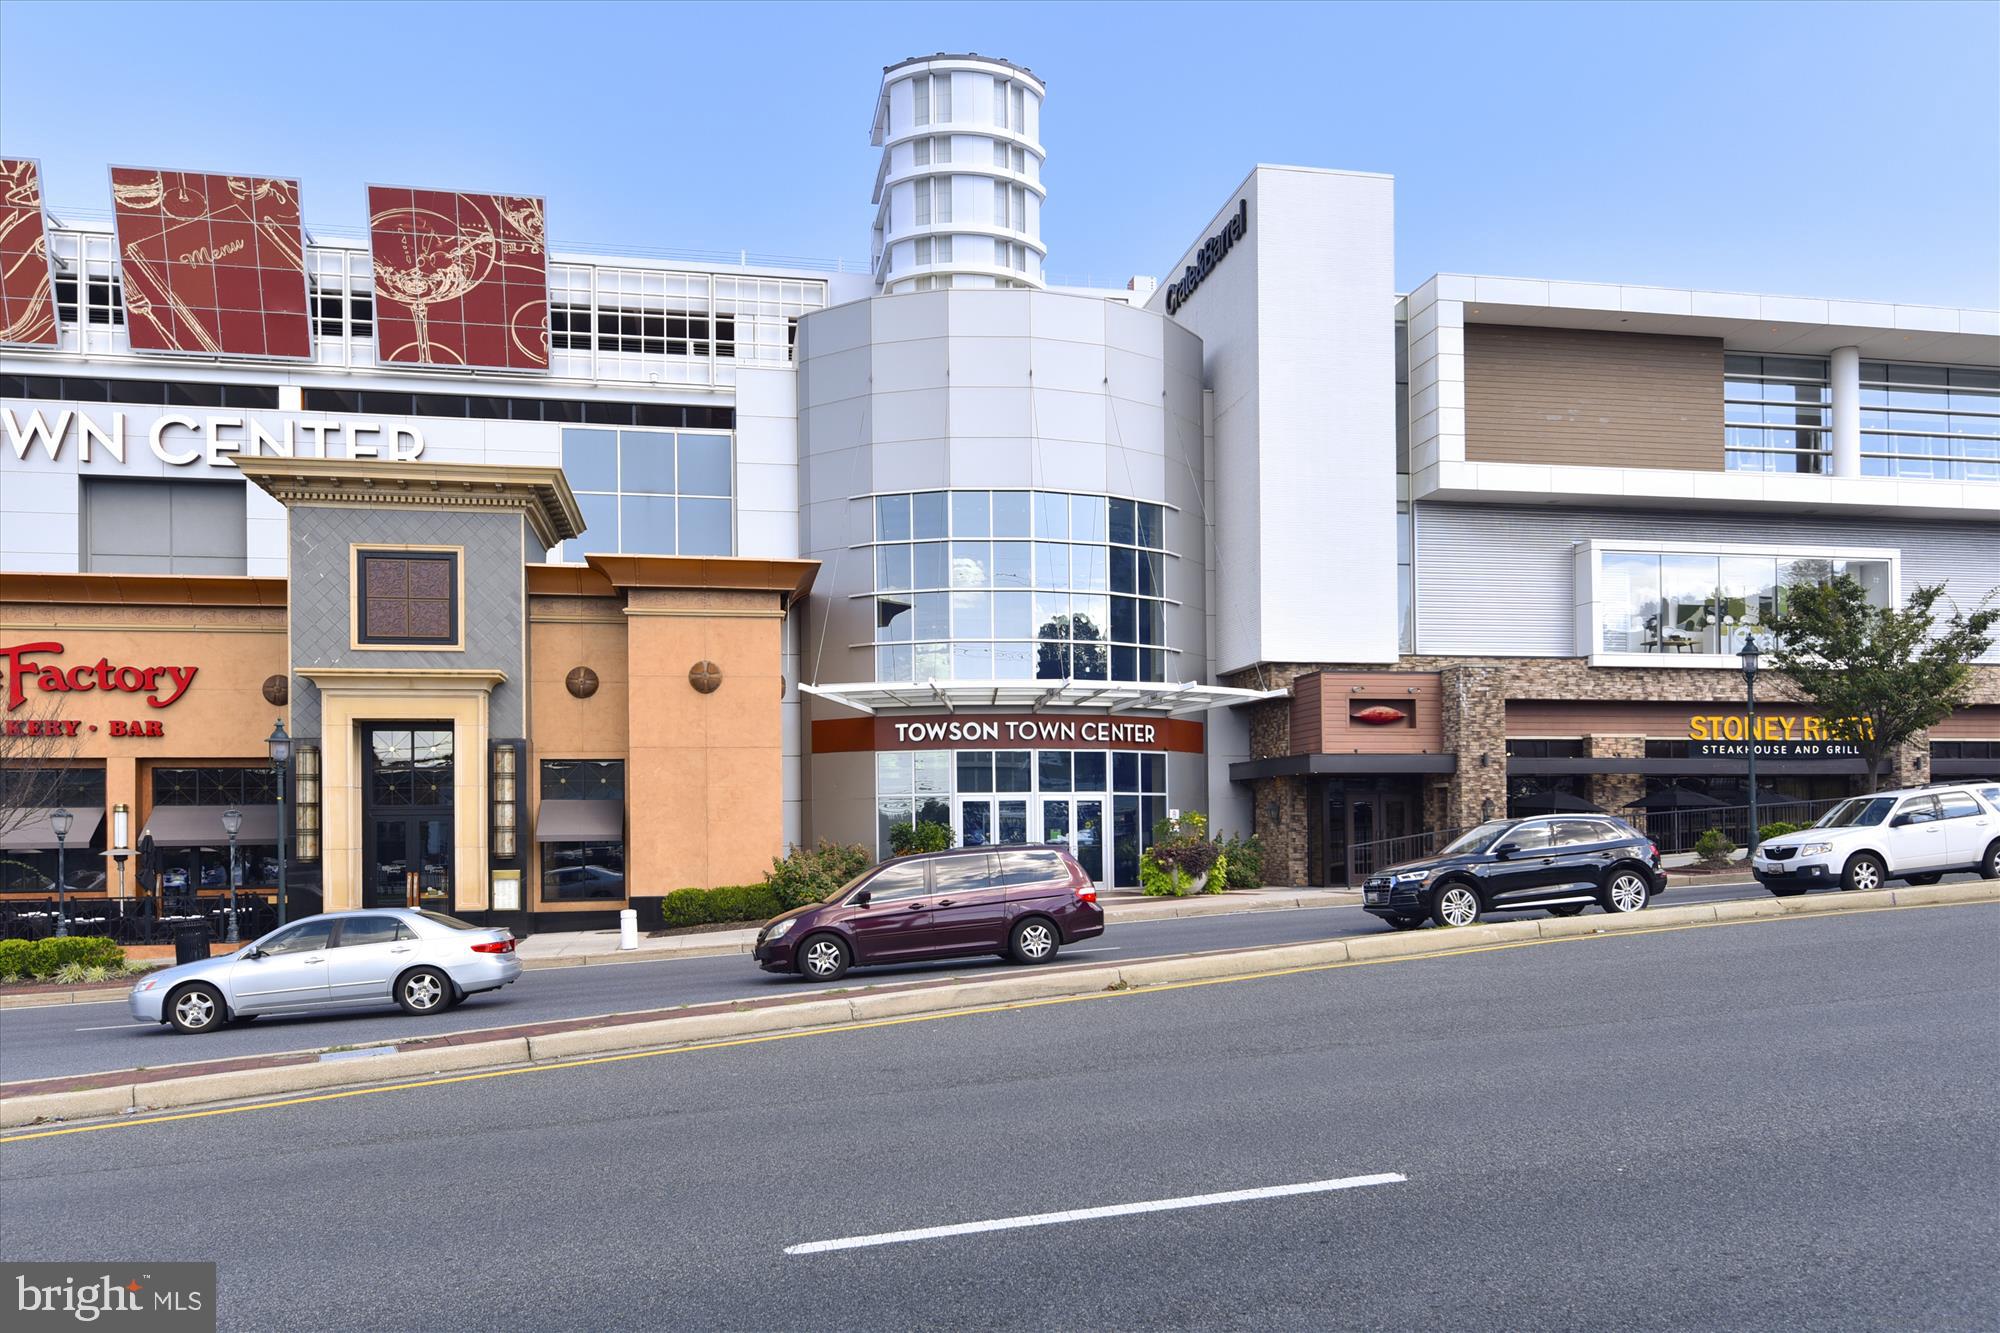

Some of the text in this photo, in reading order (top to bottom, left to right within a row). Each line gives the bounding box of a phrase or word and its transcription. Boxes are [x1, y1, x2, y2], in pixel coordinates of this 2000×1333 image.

[179, 239, 244, 269] Menu
[1166, 199, 1247, 315] Crate&Barrel
[0, 407, 425, 467] WN CENTER
[0, 641, 198, 711] Factory
[0, 719, 164, 737] KERY BAR
[895, 721, 1155, 743] TOWSON TOWN CENTER
[1690, 716, 1796, 741] STONEY
[1794, 745, 1820, 754] AND
[1826, 745, 1860, 754] GRILL
